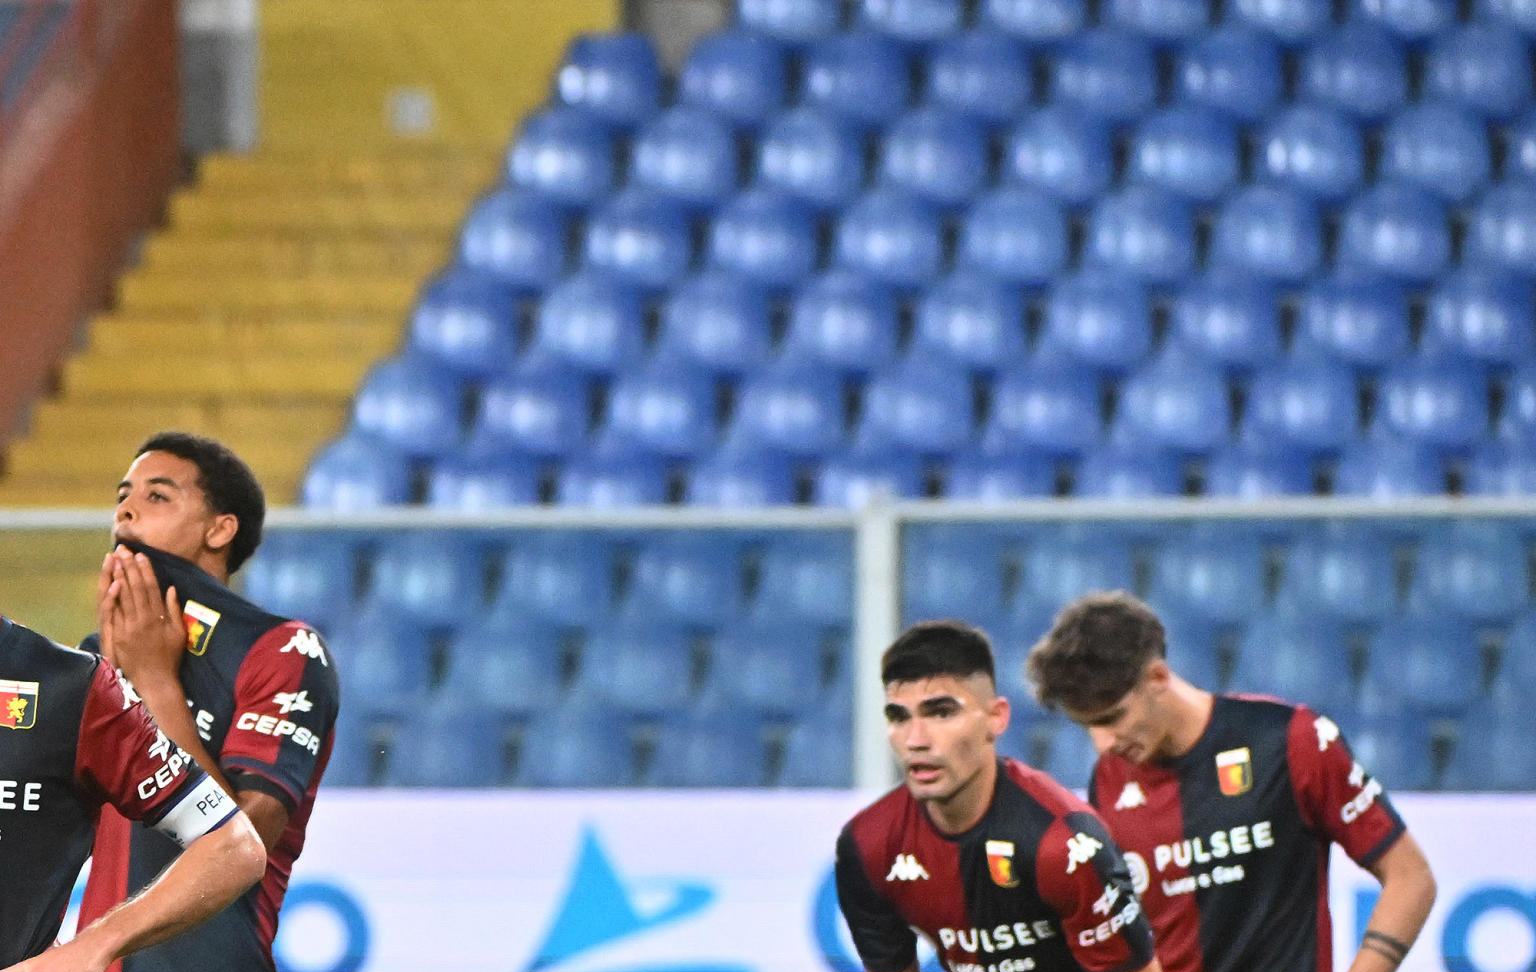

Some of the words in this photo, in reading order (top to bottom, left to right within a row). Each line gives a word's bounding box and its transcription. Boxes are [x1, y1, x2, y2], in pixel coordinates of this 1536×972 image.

[137, 747, 192, 800] CEPS
[1154, 820, 1275, 872] PULSEE
[938, 920, 1057, 953] PULSEE
[1079, 895, 1140, 947] CEPS
